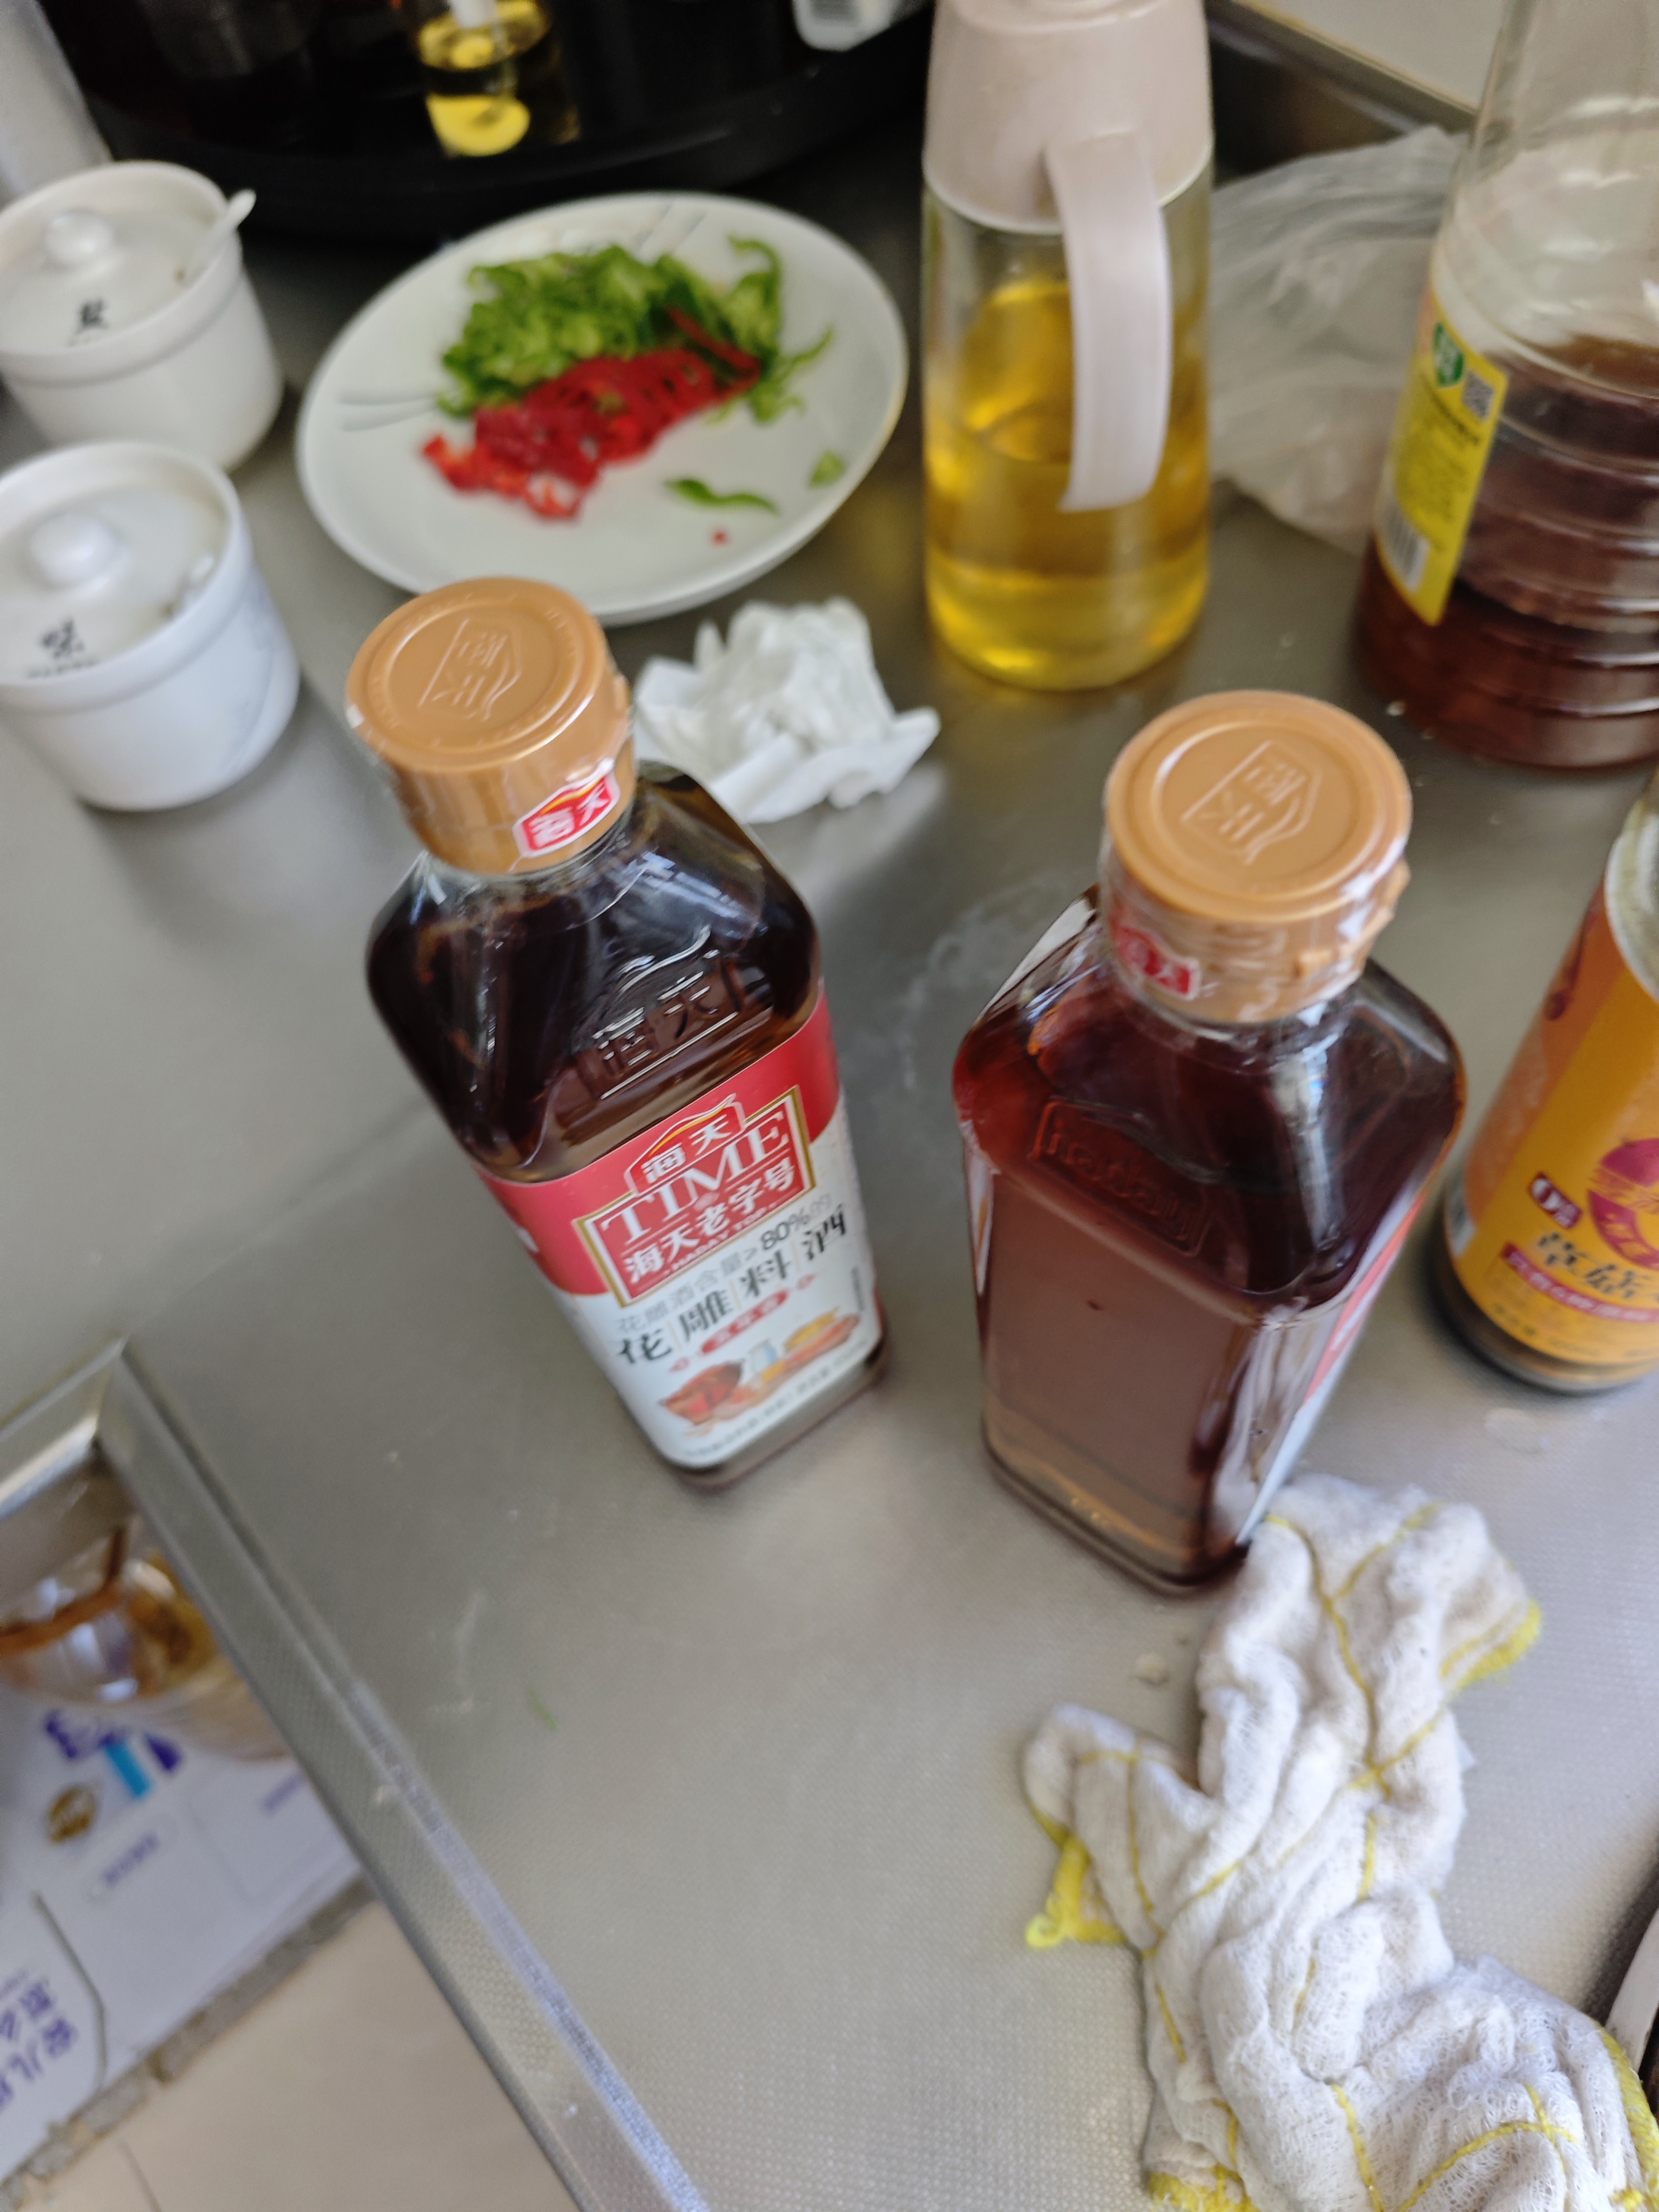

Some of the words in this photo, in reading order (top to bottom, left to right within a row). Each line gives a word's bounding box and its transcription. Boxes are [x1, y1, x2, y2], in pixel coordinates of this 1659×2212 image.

[601, 1111, 790, 1244] TIME
[640, 1114, 732, 1184] 海天
[624, 1157, 795, 1284] 海天老字号
